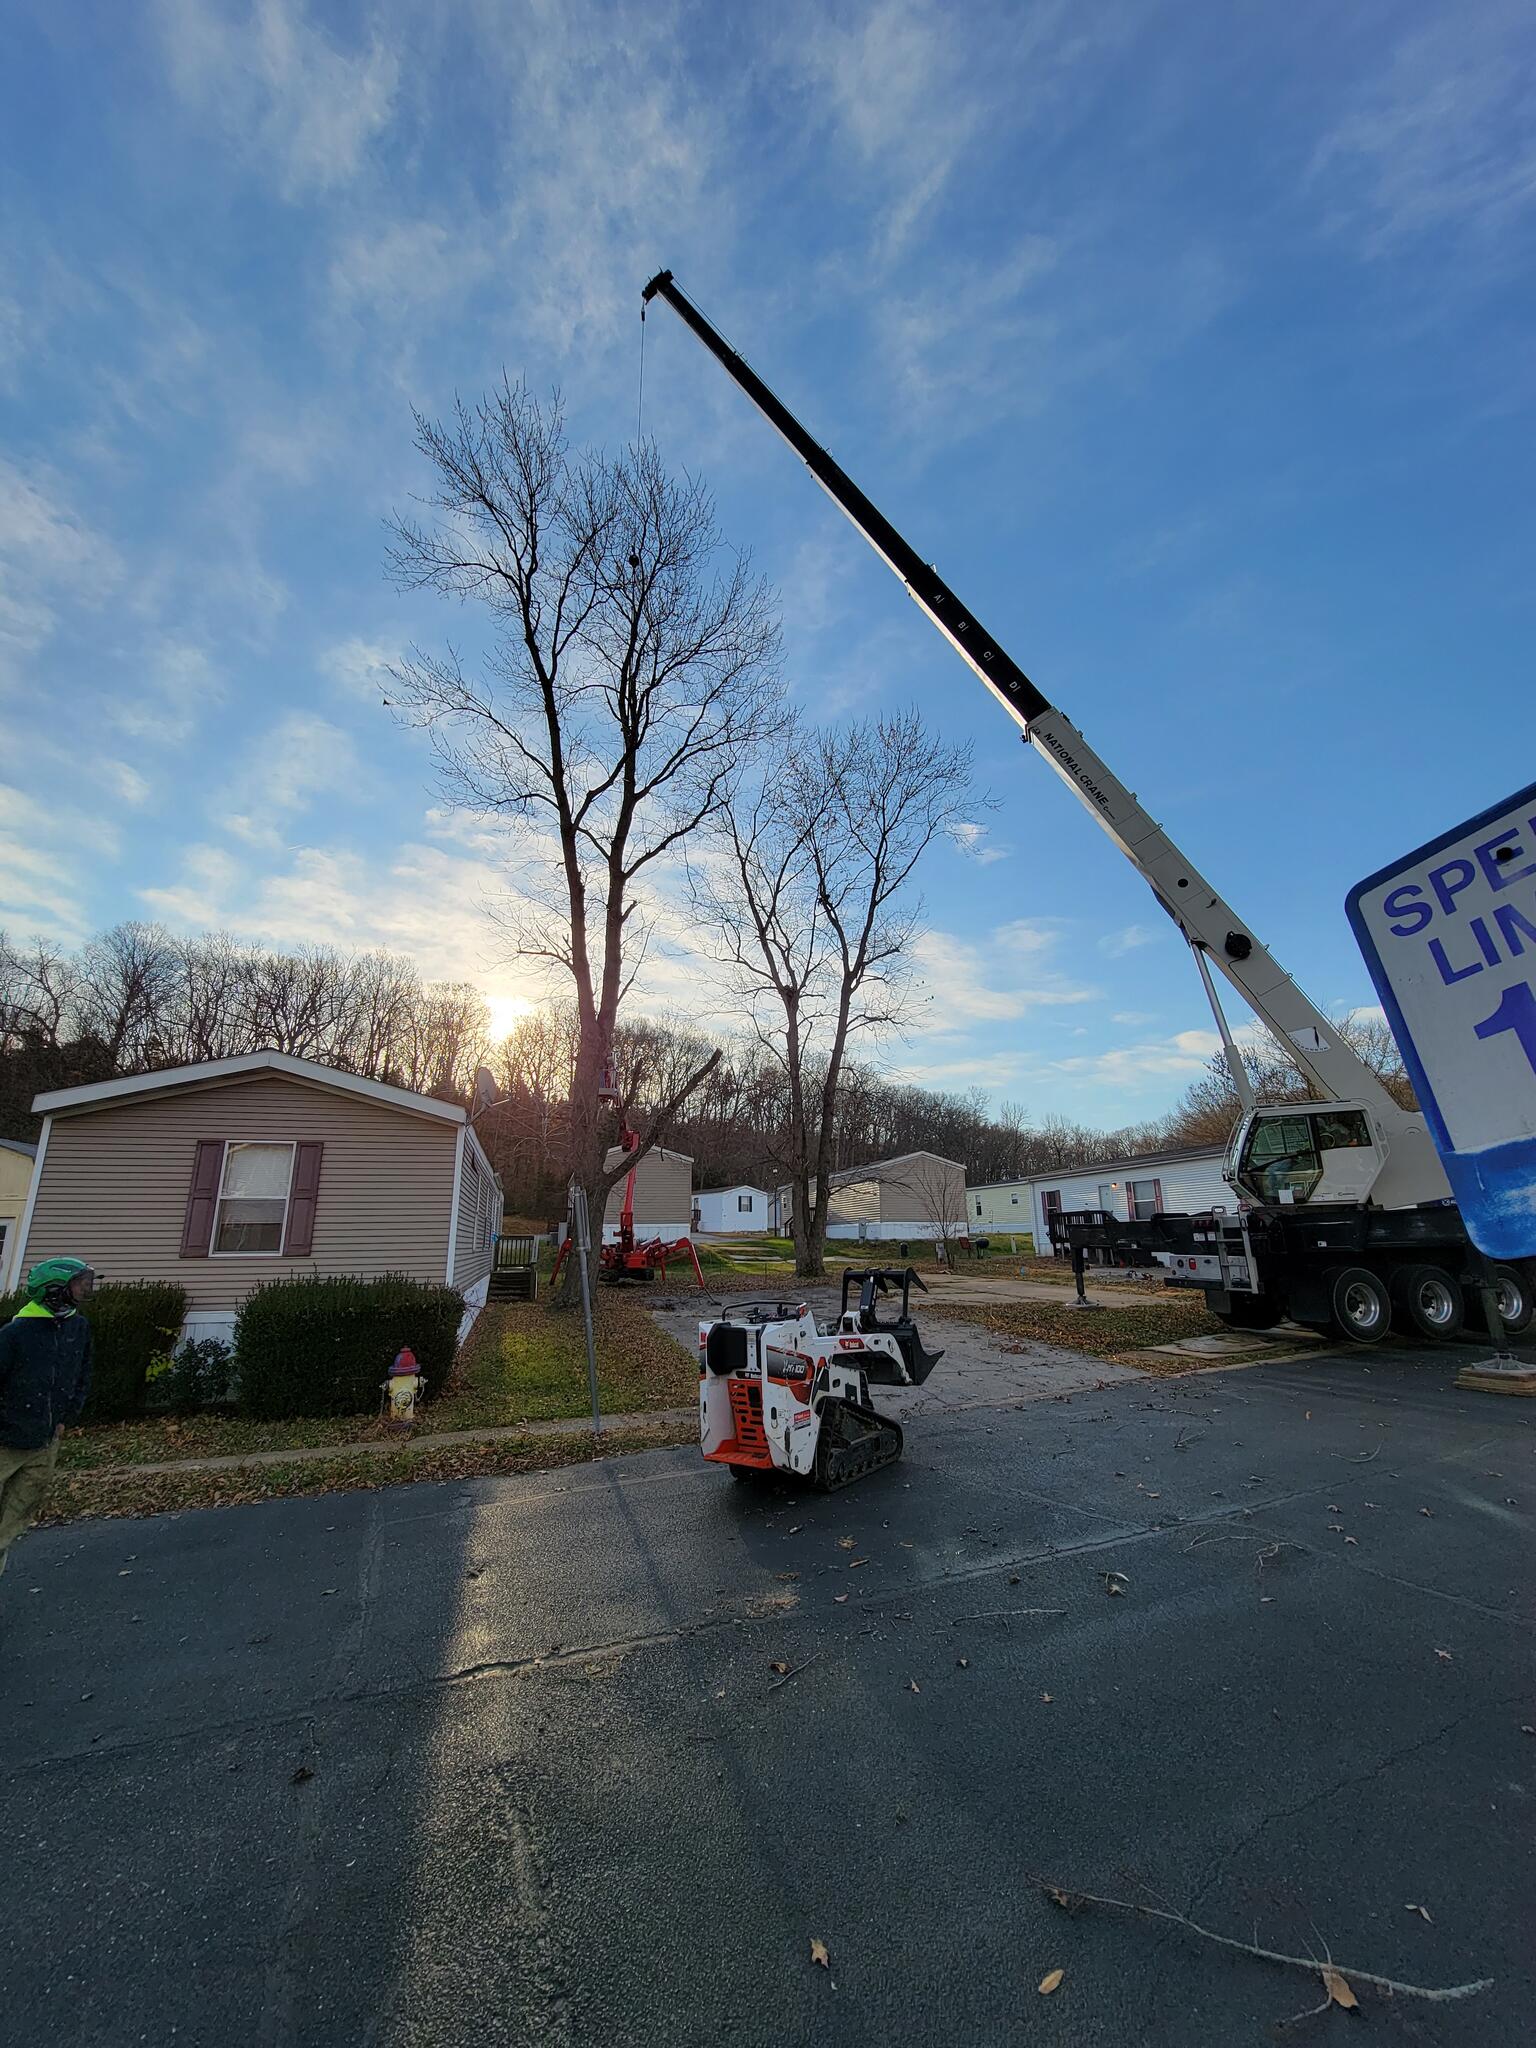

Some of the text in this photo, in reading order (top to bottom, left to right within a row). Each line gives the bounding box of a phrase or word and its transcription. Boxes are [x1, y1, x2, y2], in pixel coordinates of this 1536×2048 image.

[1044, 733, 1109, 805] NATIONAL CRANE
[1384, 816, 1536, 936] SPE
